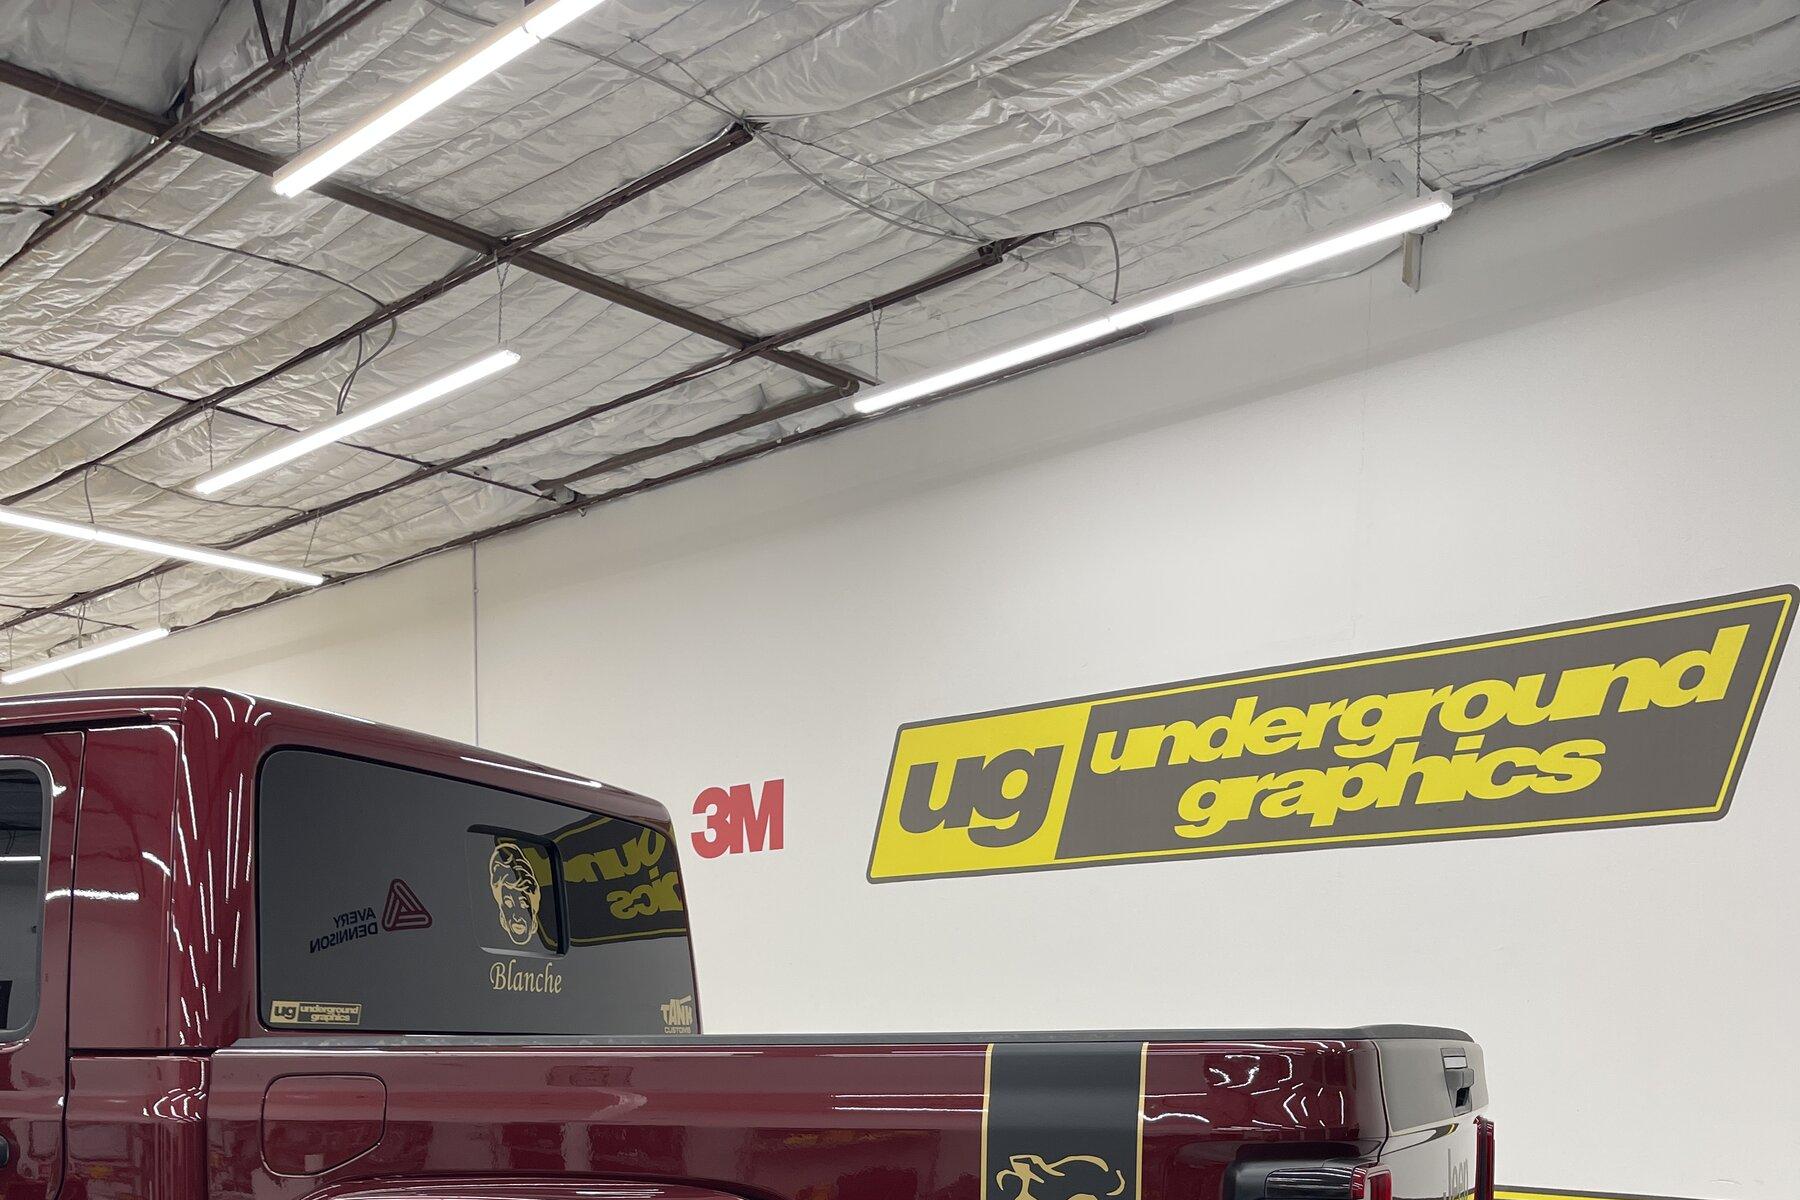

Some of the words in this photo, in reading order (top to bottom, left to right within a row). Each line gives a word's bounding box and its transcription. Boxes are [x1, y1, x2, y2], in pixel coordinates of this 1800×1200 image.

[1091, 625, 1750, 775] underground
[899, 744, 1065, 848] ug
[1175, 734, 1607, 839] graphics
[691, 779, 785, 859] 3M
[490, 959, 562, 994] Blanche
[274, 1005, 297, 1020] ug
[300, 1004, 359, 1014] underground
[310, 1013, 351, 1022] graphics
